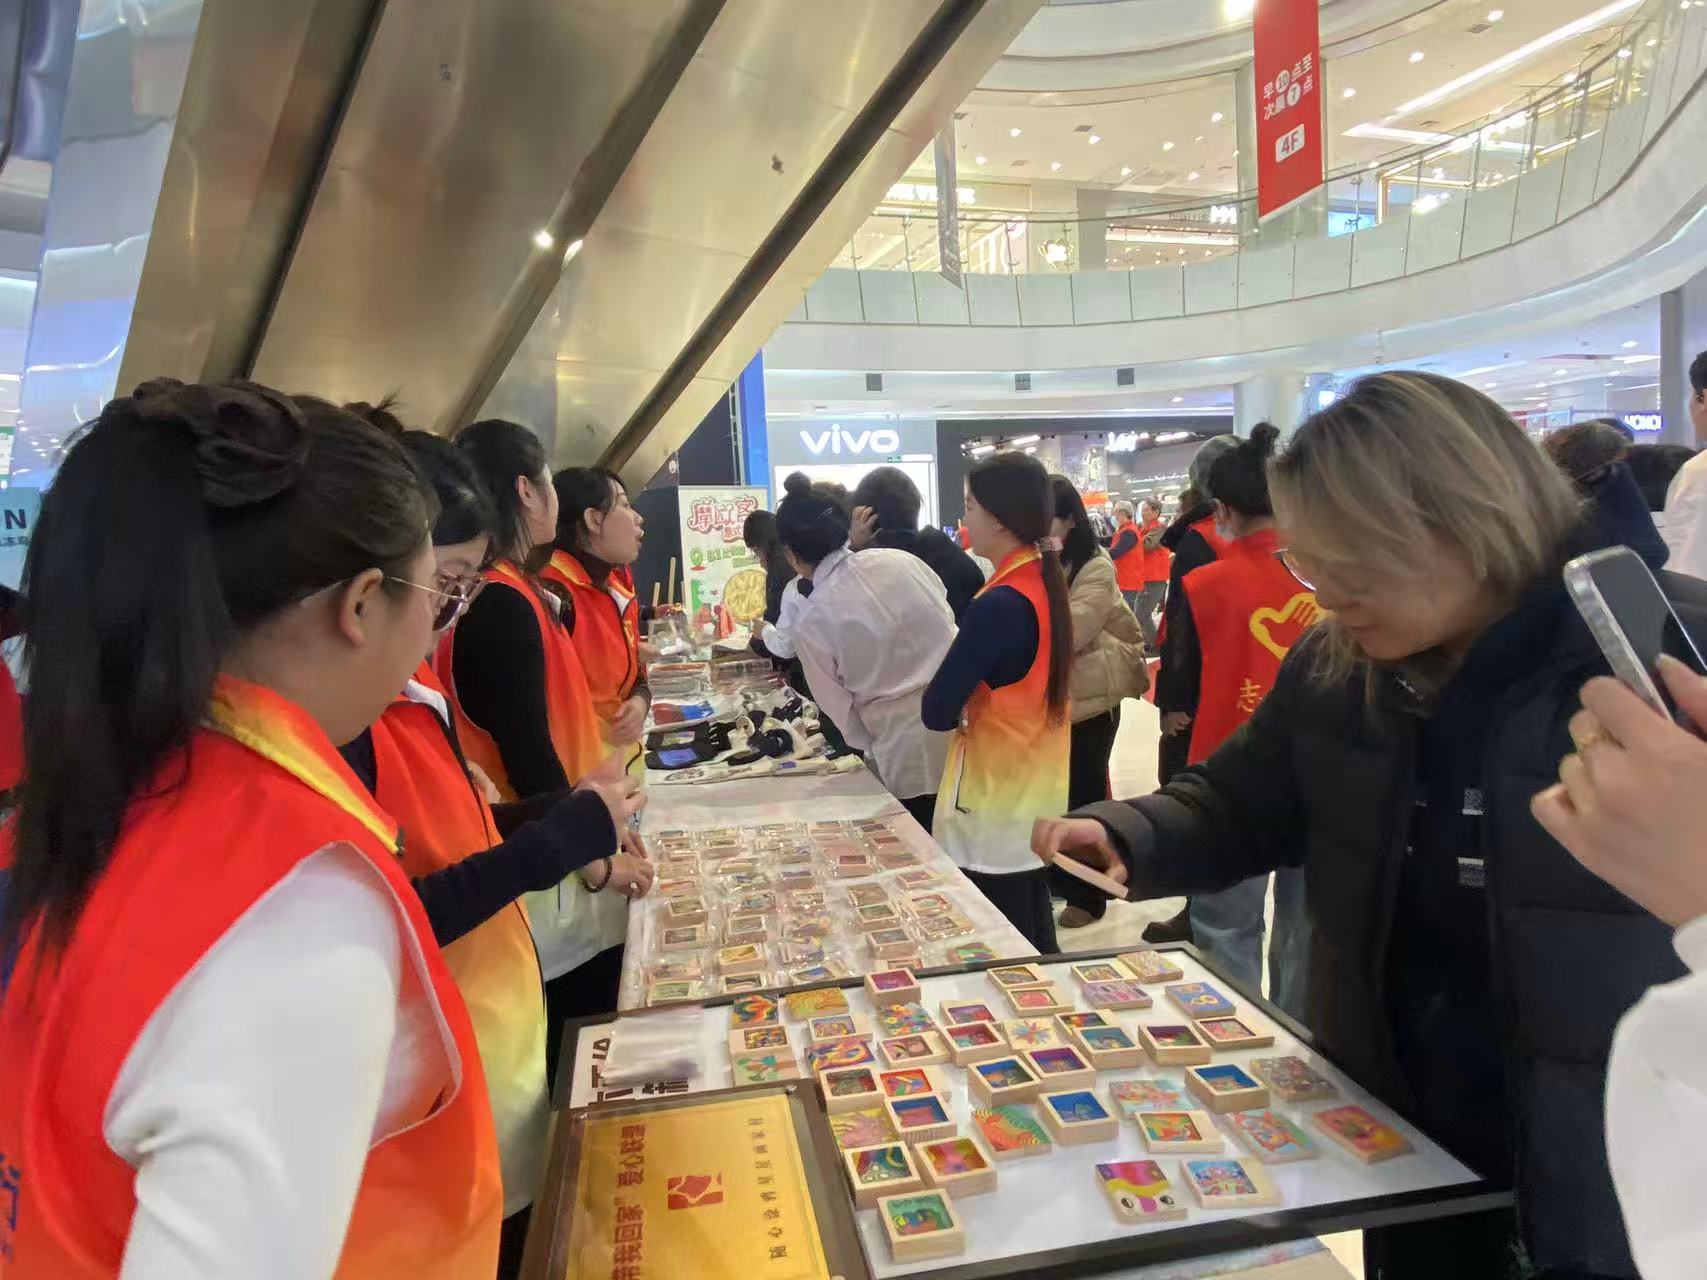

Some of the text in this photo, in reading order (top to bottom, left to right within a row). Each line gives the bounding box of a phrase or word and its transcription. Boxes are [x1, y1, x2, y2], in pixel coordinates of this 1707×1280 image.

[1281, 131, 1299, 154] 4F
[799, 424, 900, 455] vivo
[1236, 677, 1264, 713] 志
